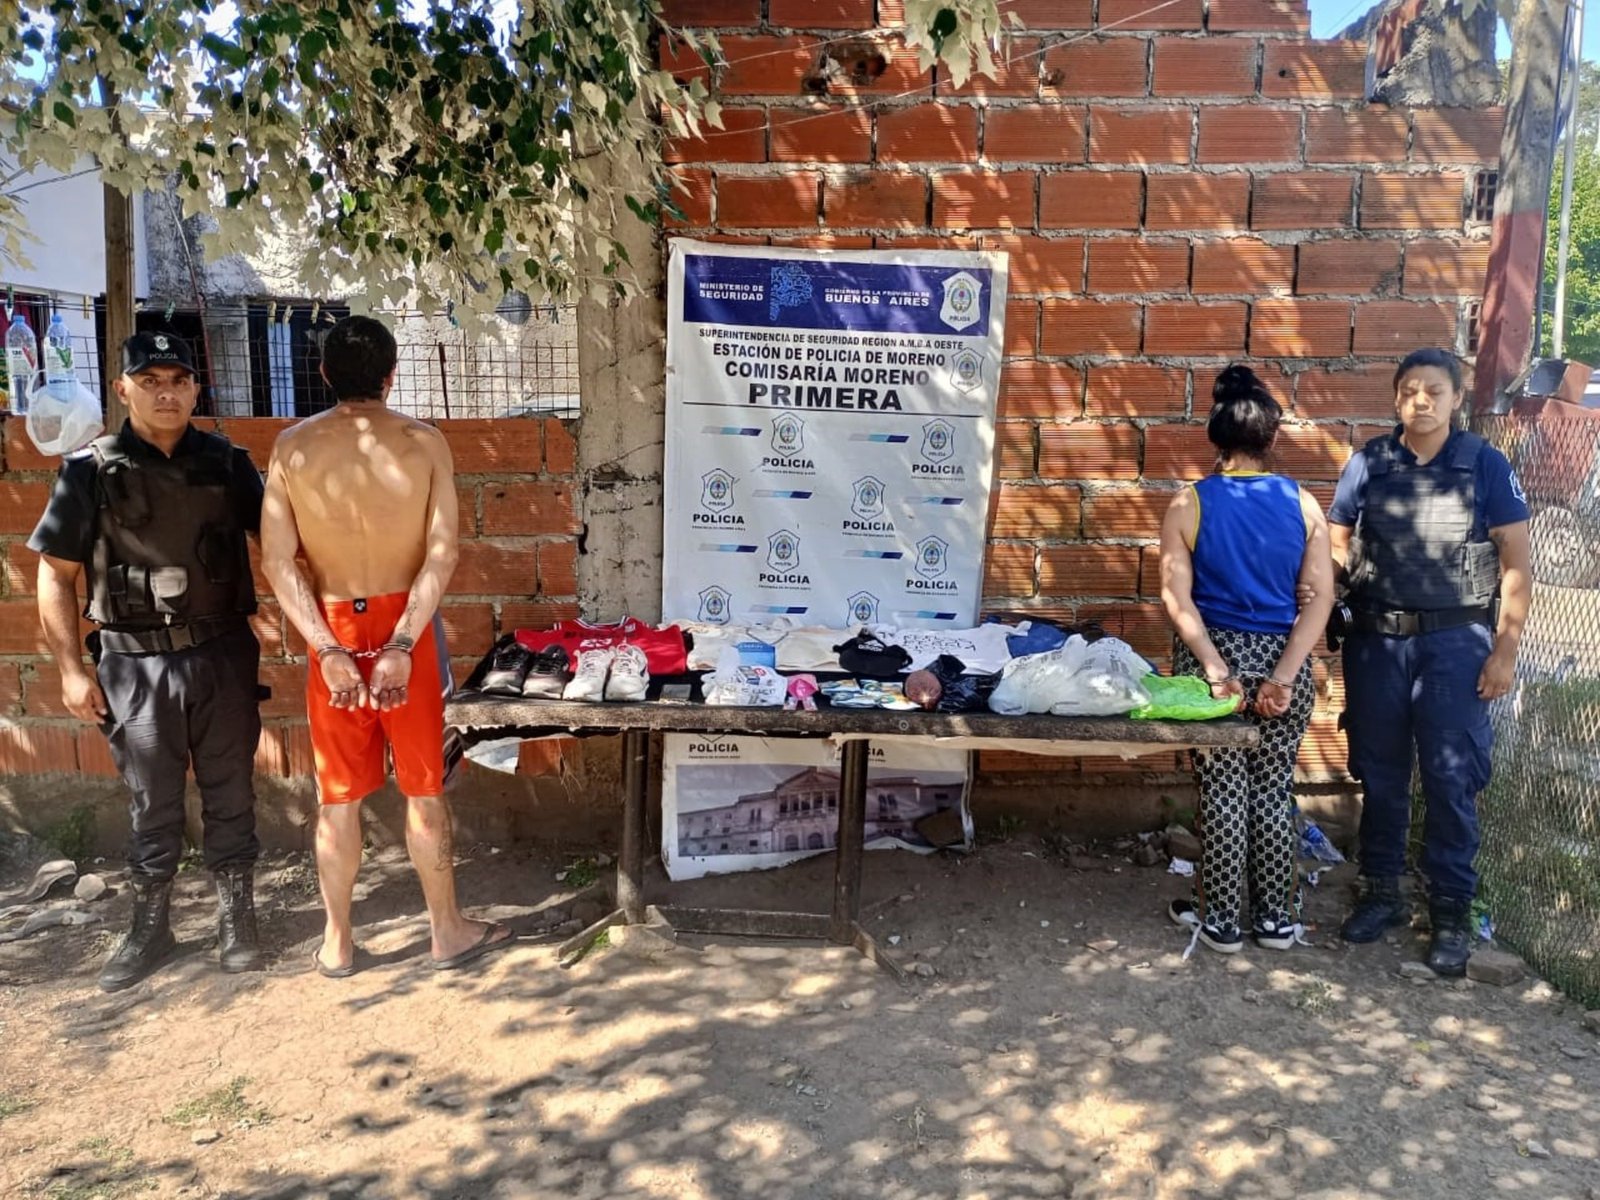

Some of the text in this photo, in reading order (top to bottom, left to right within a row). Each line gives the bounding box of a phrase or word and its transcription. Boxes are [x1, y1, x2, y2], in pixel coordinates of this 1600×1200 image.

[700, 282, 750, 291] MINISTERIO
[700, 290, 764, 301] SEGURIDAD
[825, 293, 929, 307] BUENOS AIRES
[699, 328, 790, 342] SUPERINTENDENCIA
[793, 334, 805, 343] DE
[807, 334, 860, 346] SEGURIDAD
[862, 336, 897, 347] REGION
[934, 340, 963, 350] OESTE
[713, 343, 945, 367] ESTACIÓN DE POLICIA DE MORENO
[725, 361, 929, 385] COMISARÍA MORENO
[749, 383, 902, 410] PRIMERA
[763, 457, 814, 469] POLICIA
[912, 464, 964, 474] POLICIA
[693, 513, 744, 524] POLICIA
[843, 520, 894, 531] POLICIA
[760, 573, 810, 584] POLICIA
[906, 579, 958, 590] POLICIA
[689, 743, 739, 752] POLICIA
